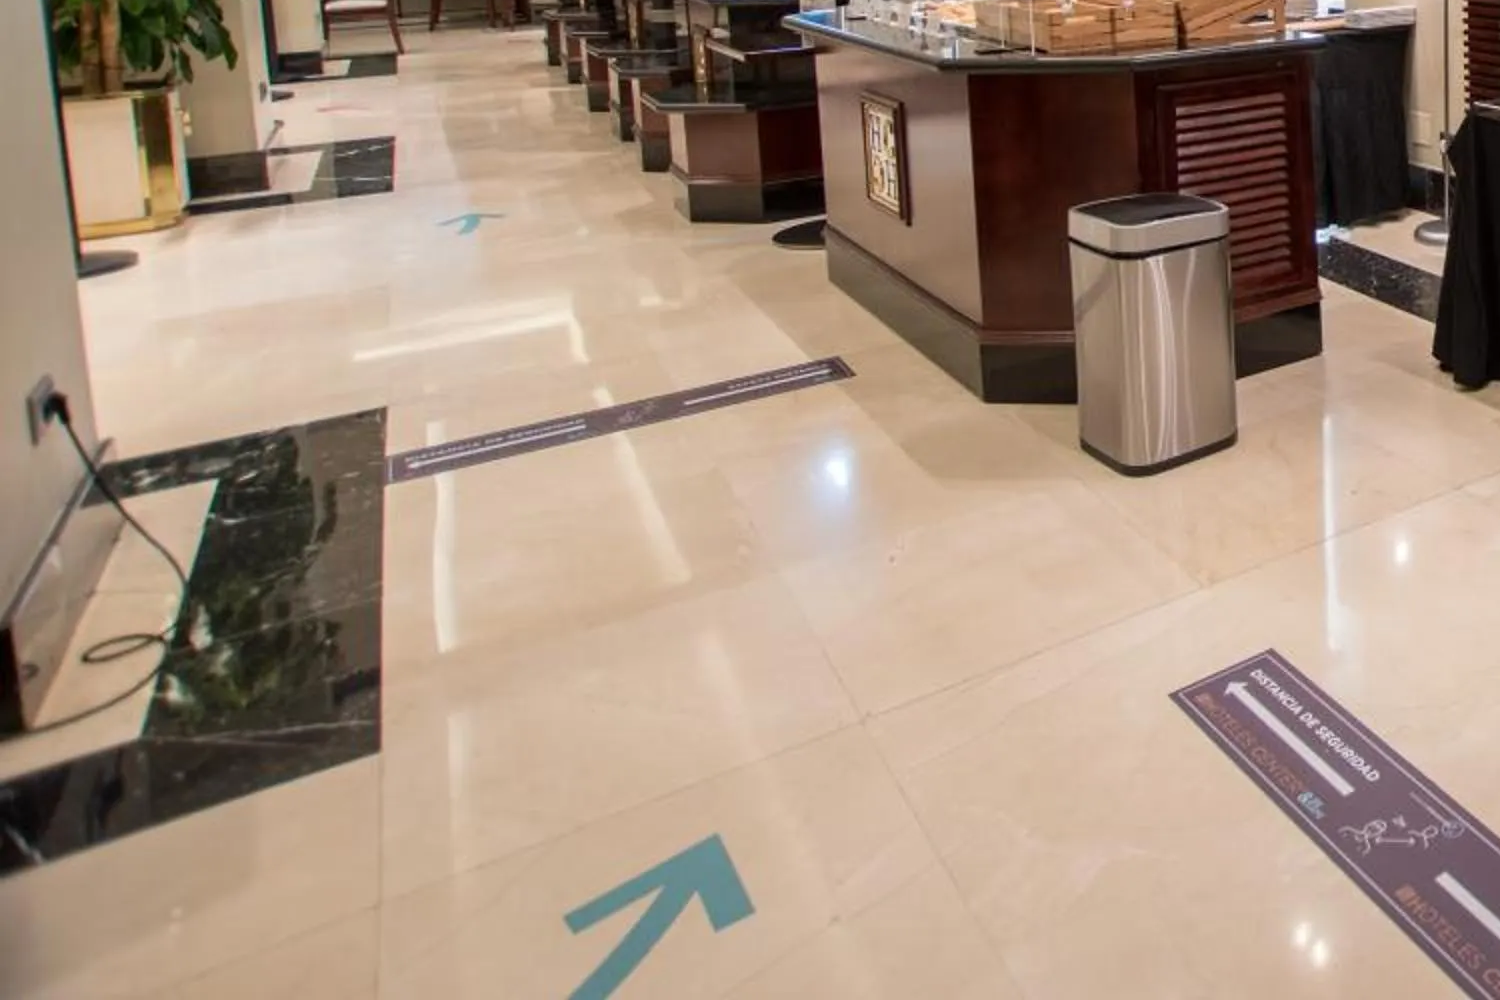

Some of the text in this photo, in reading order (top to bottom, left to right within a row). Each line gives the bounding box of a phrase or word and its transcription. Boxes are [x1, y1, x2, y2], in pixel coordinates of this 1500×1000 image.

[1250, 668, 1380, 782] DISTANCIA DE SEGURIDAD
[1408, 894, 1487, 969] HOTELES
